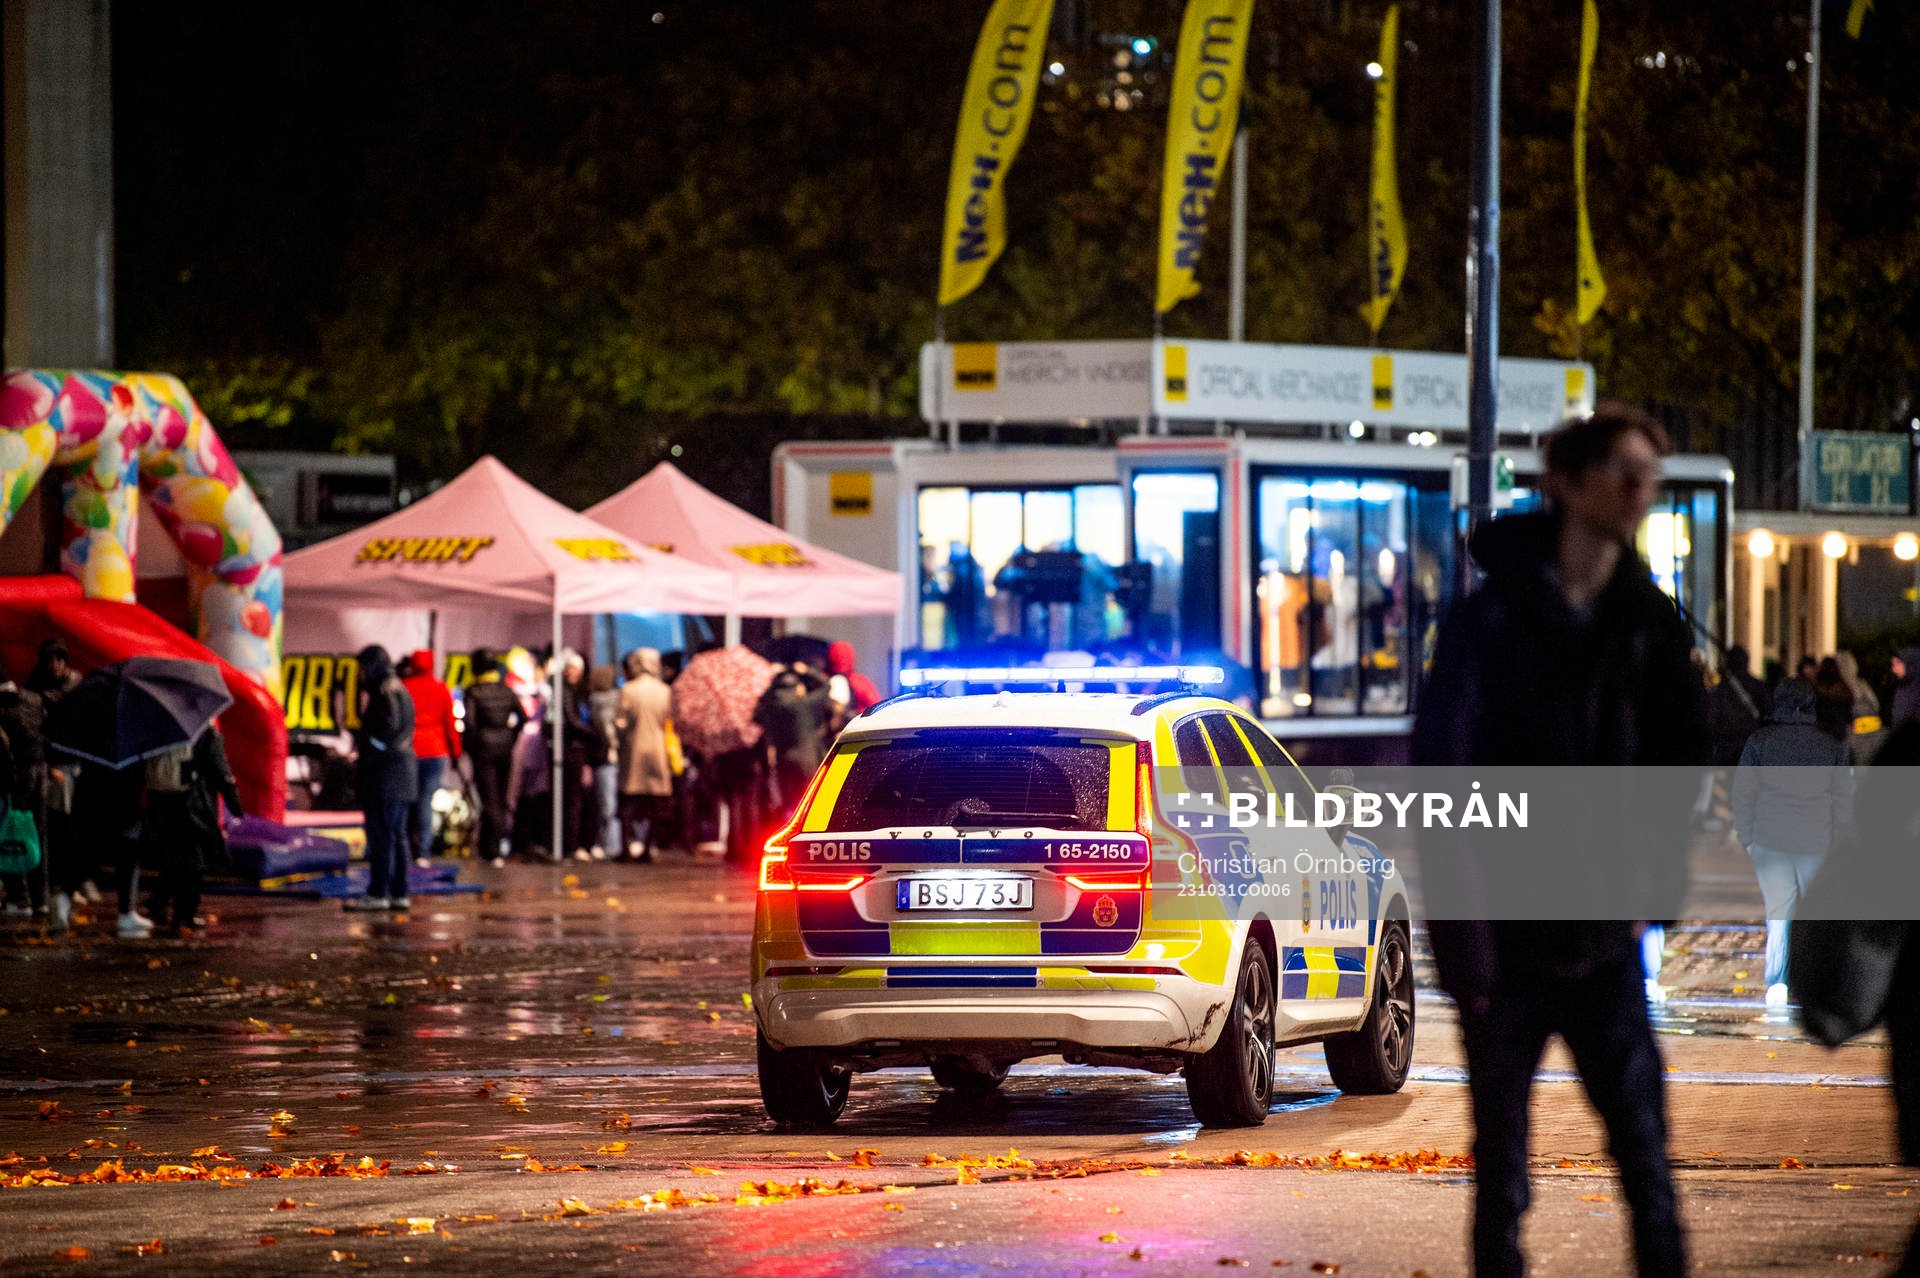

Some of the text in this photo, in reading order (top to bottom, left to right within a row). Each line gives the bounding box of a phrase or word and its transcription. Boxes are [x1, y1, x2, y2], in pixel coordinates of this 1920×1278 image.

[889, 830, 1034, 840] VOLVO
[808, 842, 871, 860] POLIS
[1044, 843, 1131, 859] 1 65-2150
[918, 883, 1024, 906] BSJ 73J
[1320, 879, 1357, 930] POLIS
